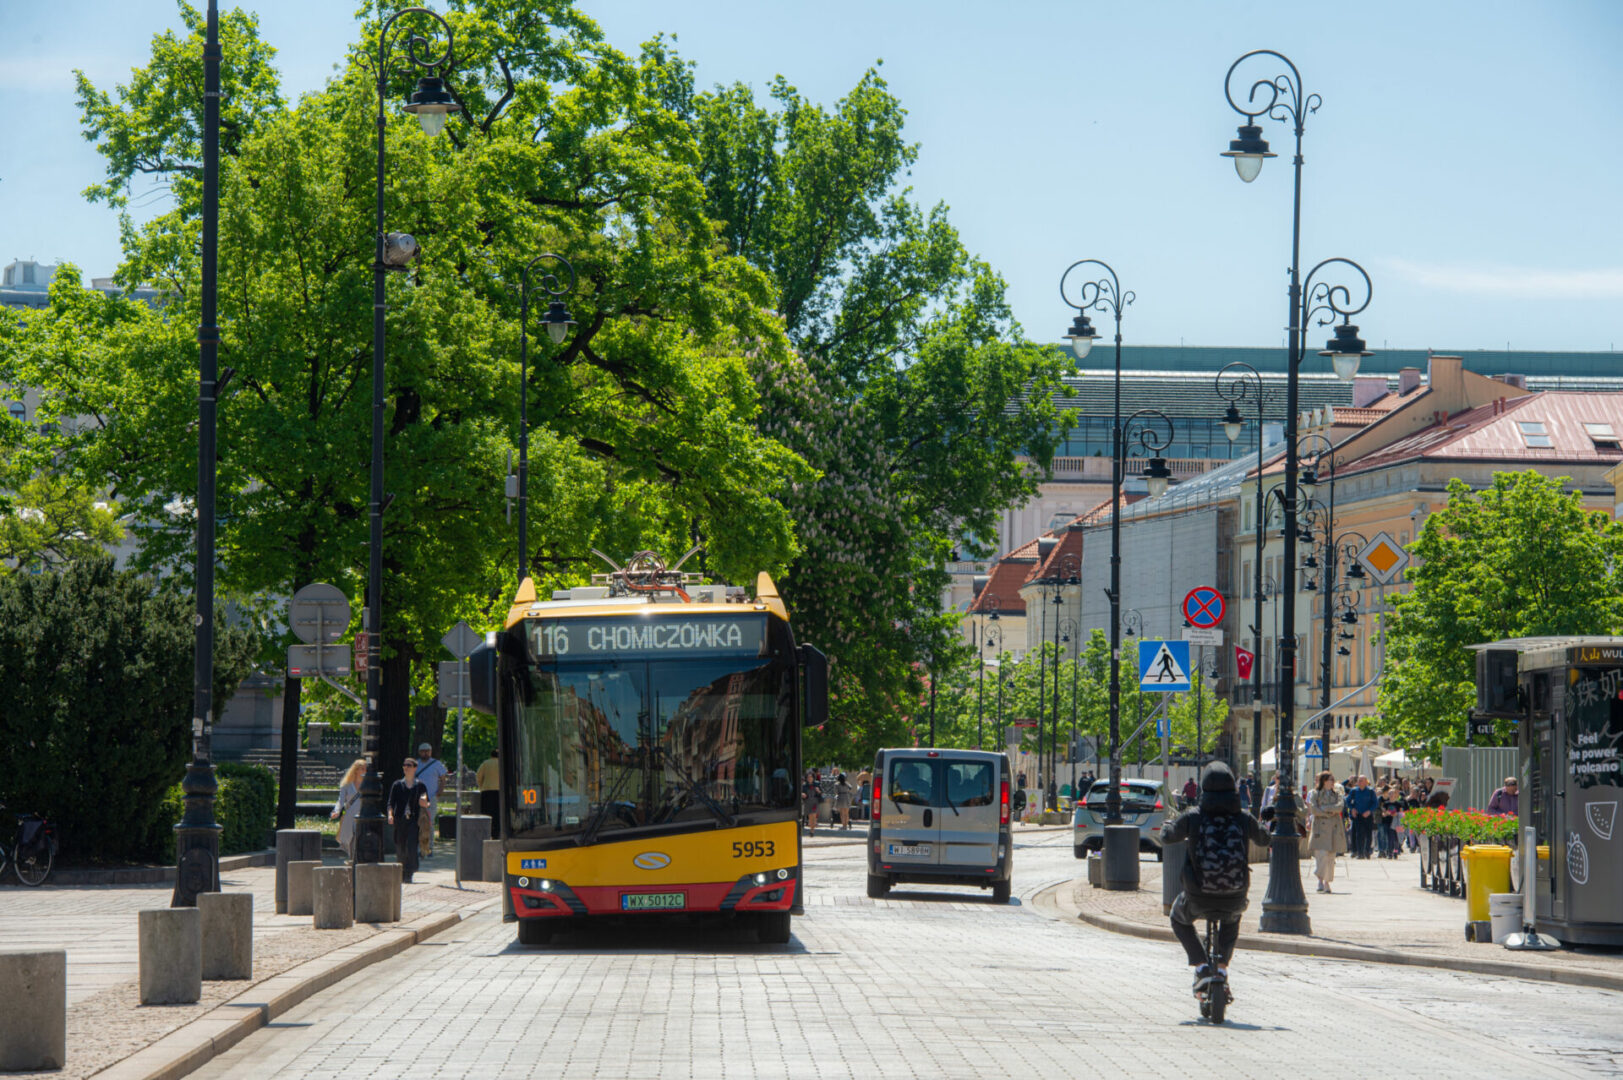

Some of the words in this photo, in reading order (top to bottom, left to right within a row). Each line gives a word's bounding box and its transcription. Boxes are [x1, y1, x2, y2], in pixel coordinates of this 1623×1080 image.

[533, 626, 569, 655] 116
[587, 622, 742, 650] CHOMICZÓWKA
[1577, 732, 1598, 744] Feel
[1569, 749, 1580, 760] the
[1582, 748, 1617, 761] power
[1569, 763, 1576, 774] of
[1577, 762, 1619, 773] volcano
[522, 789, 537, 804] 10
[732, 841, 775, 858] 5953
[629, 895, 644, 907] WX
[648, 895, 682, 906] 5012C
